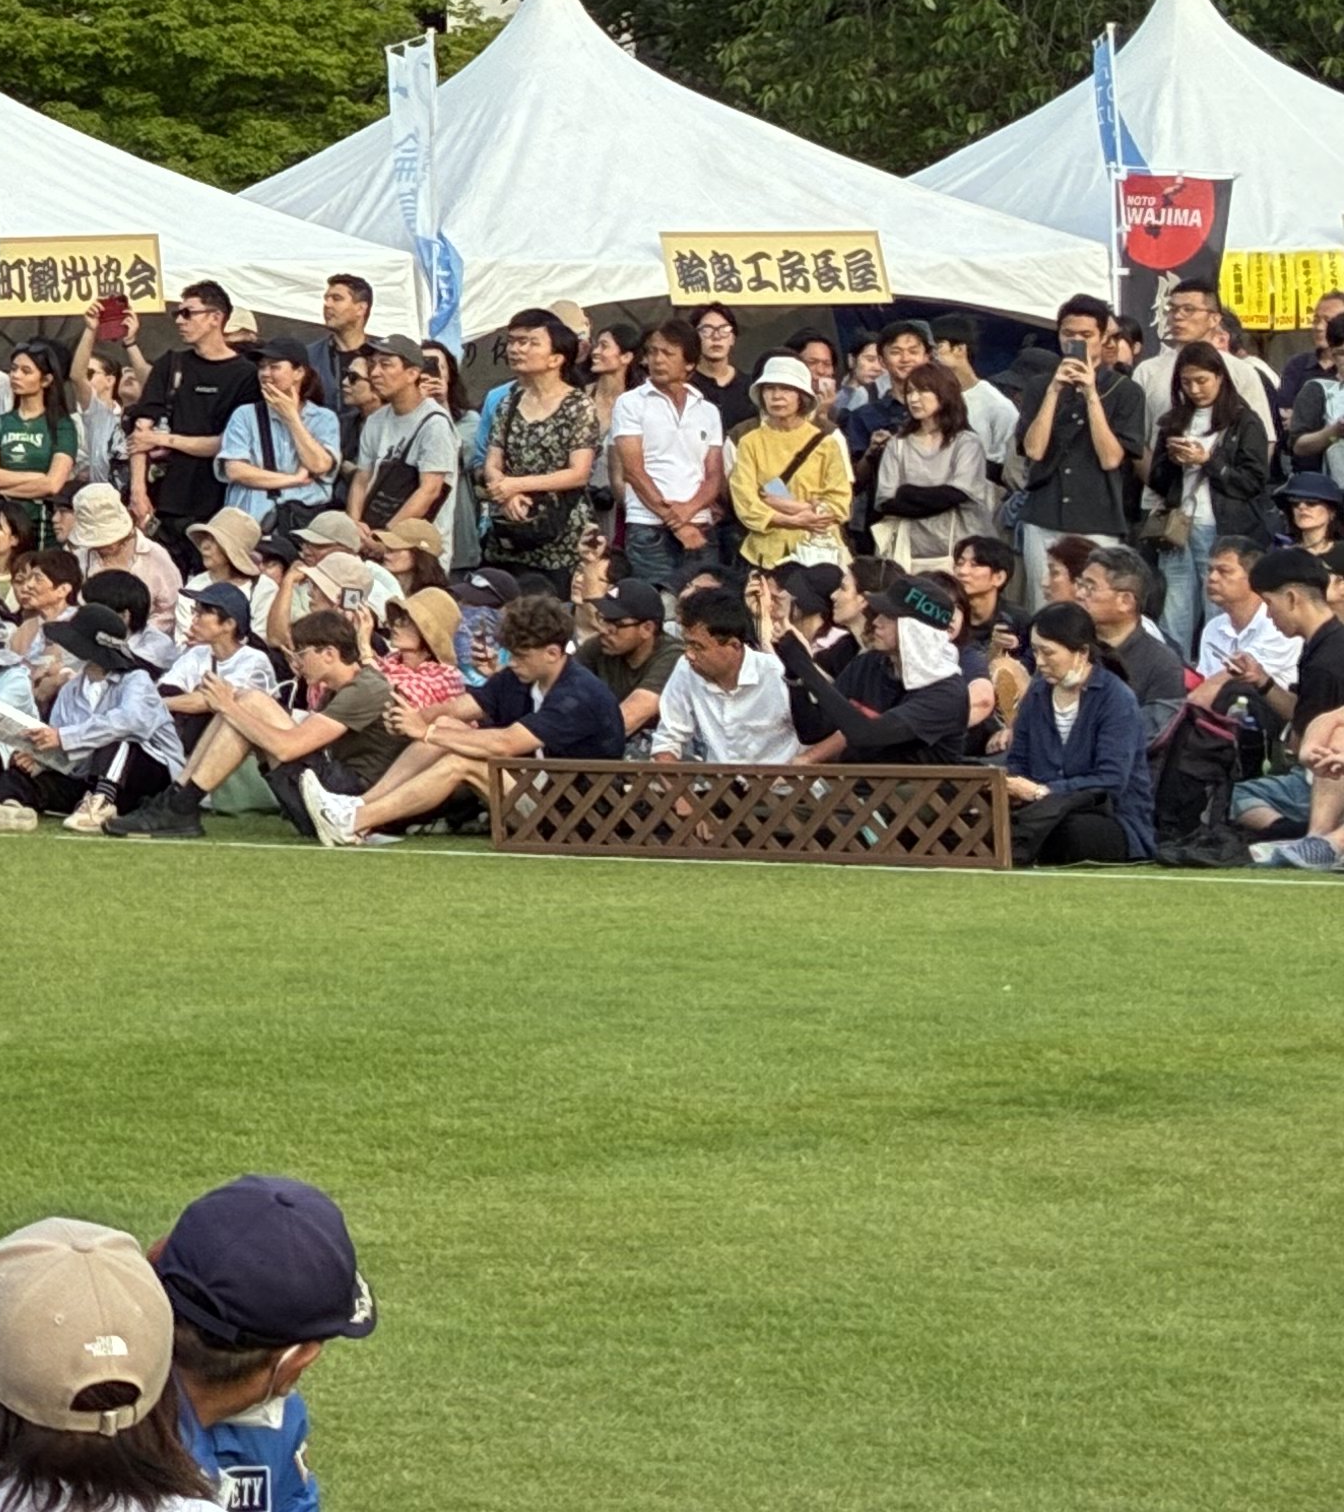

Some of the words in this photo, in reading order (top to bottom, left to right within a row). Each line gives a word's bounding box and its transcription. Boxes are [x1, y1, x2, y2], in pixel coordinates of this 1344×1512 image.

[1126, 196, 1156, 207] NOTO
[1126, 207, 1202, 227] WAJIMA
[672, 249, 883, 294] 輪島工房長屋
